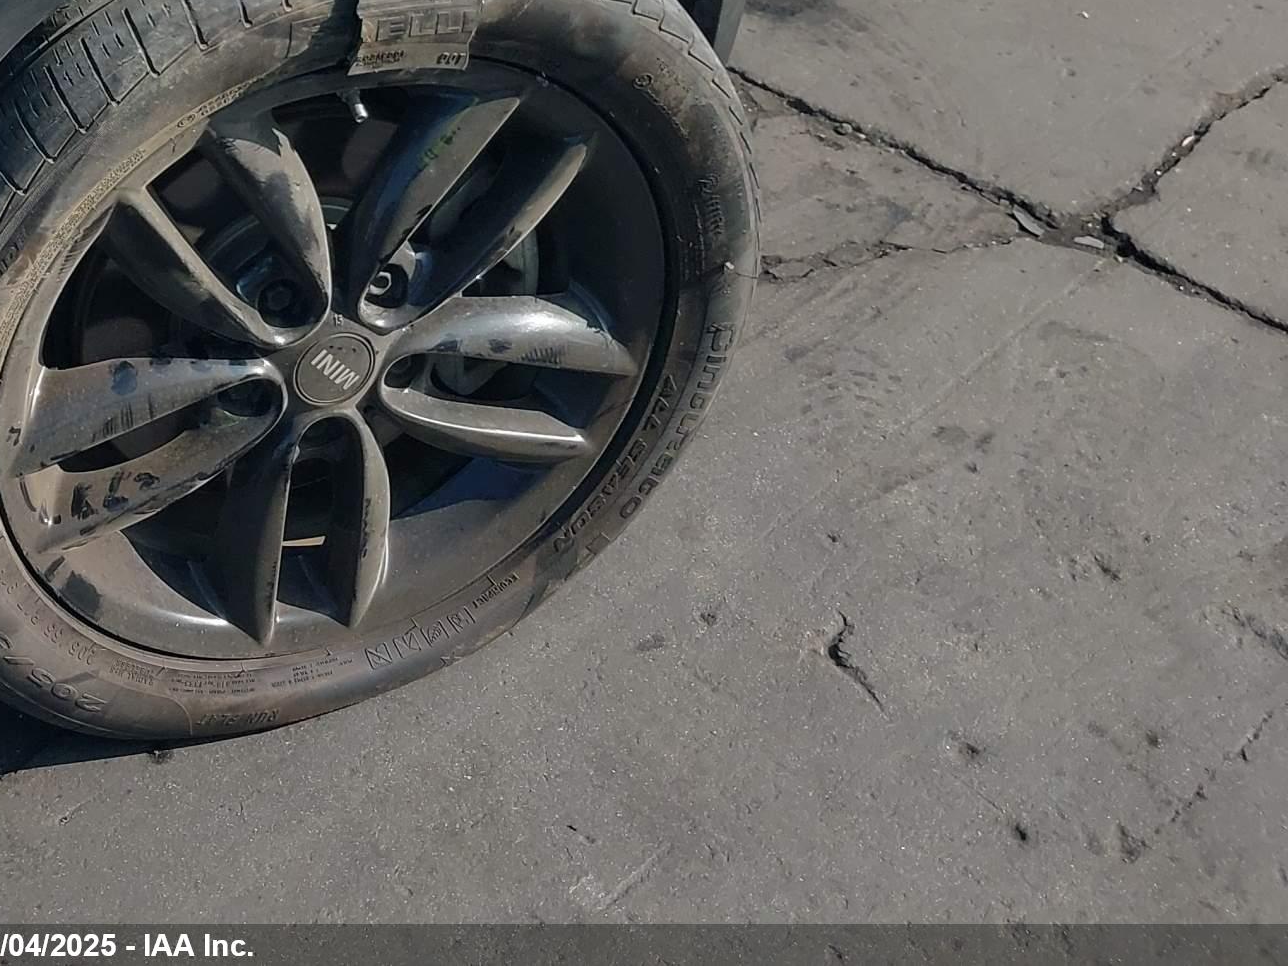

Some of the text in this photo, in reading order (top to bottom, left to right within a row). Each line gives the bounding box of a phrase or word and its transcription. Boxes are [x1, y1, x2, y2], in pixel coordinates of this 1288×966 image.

[311, 349, 360, 389] MINI
[553, 373, 677, 552] ALL SEASON
